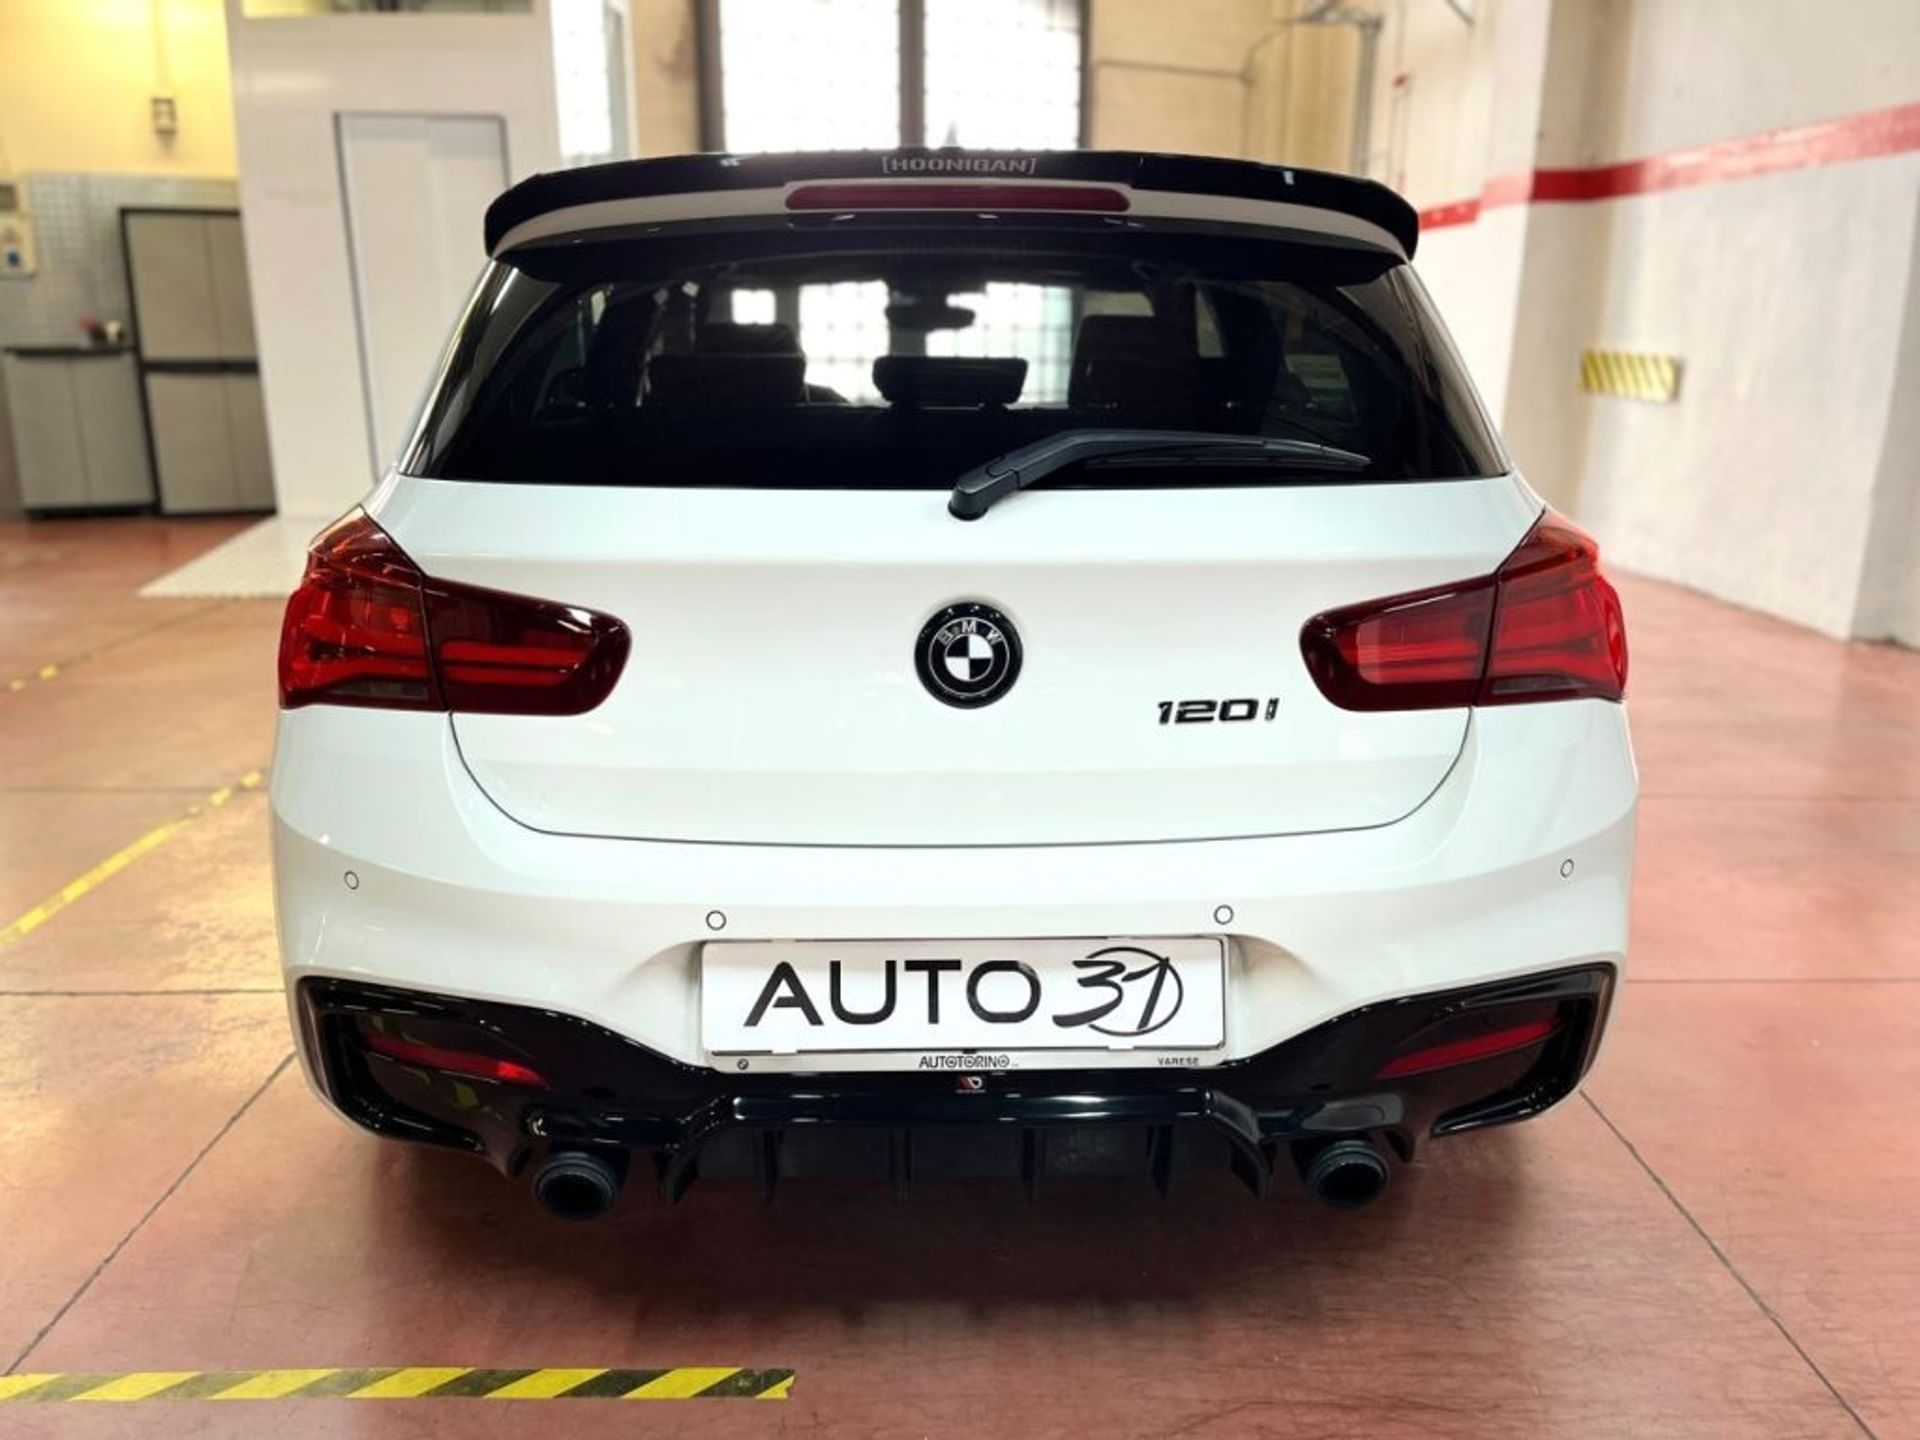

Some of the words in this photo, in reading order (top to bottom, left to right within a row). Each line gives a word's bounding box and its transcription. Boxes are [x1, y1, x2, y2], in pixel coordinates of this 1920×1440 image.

[936, 620, 1003, 645] BMW
[743, 960, 1042, 1027] AUTO
[919, 1055, 1009, 1068] AUTOTORINO
[1157, 1057, 1199, 1065] VARESE
